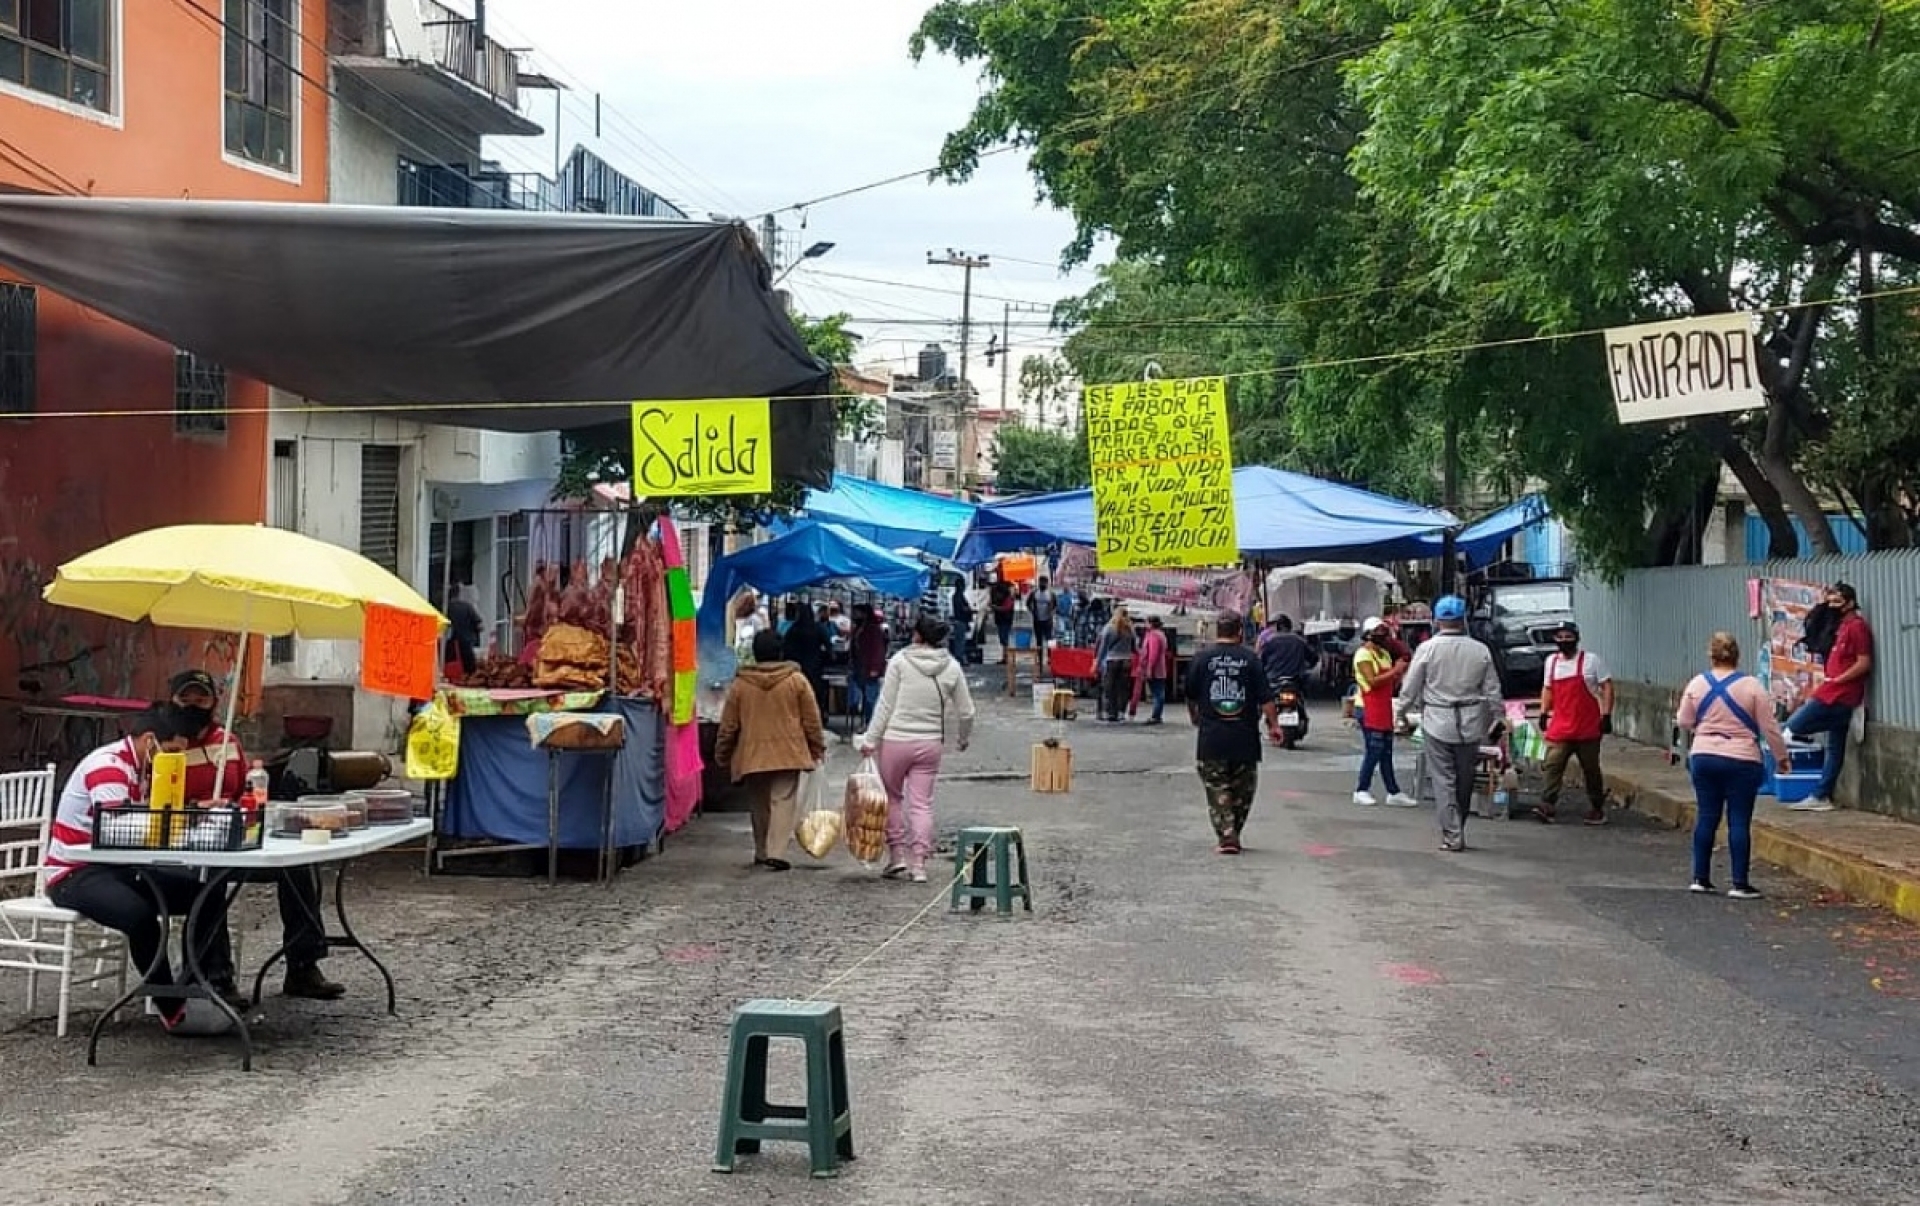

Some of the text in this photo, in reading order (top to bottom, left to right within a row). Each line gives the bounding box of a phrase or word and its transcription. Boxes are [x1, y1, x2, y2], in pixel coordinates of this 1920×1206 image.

[1610, 328, 1752, 403] ENTRADA
[1090, 378, 1220, 405] SE LES PIDE
[1090, 394, 1210, 418] DE FABOR A
[1173, 411, 1217, 429] QUE
[639, 408, 758, 489] Salida
[1091, 429, 1178, 450] TRAIGAN
[1139, 462, 1161, 480] TU
[1176, 459, 1225, 477] VIDA
[1117, 481, 1139, 497] MI
[1147, 478, 1187, 493] VIDA
[1199, 472, 1222, 488] TU
[1097, 489, 1230, 518] VALES MUCHO
[1097, 506, 1229, 538] MANTEN TU
[1101, 526, 1231, 556] DISTANCIA
